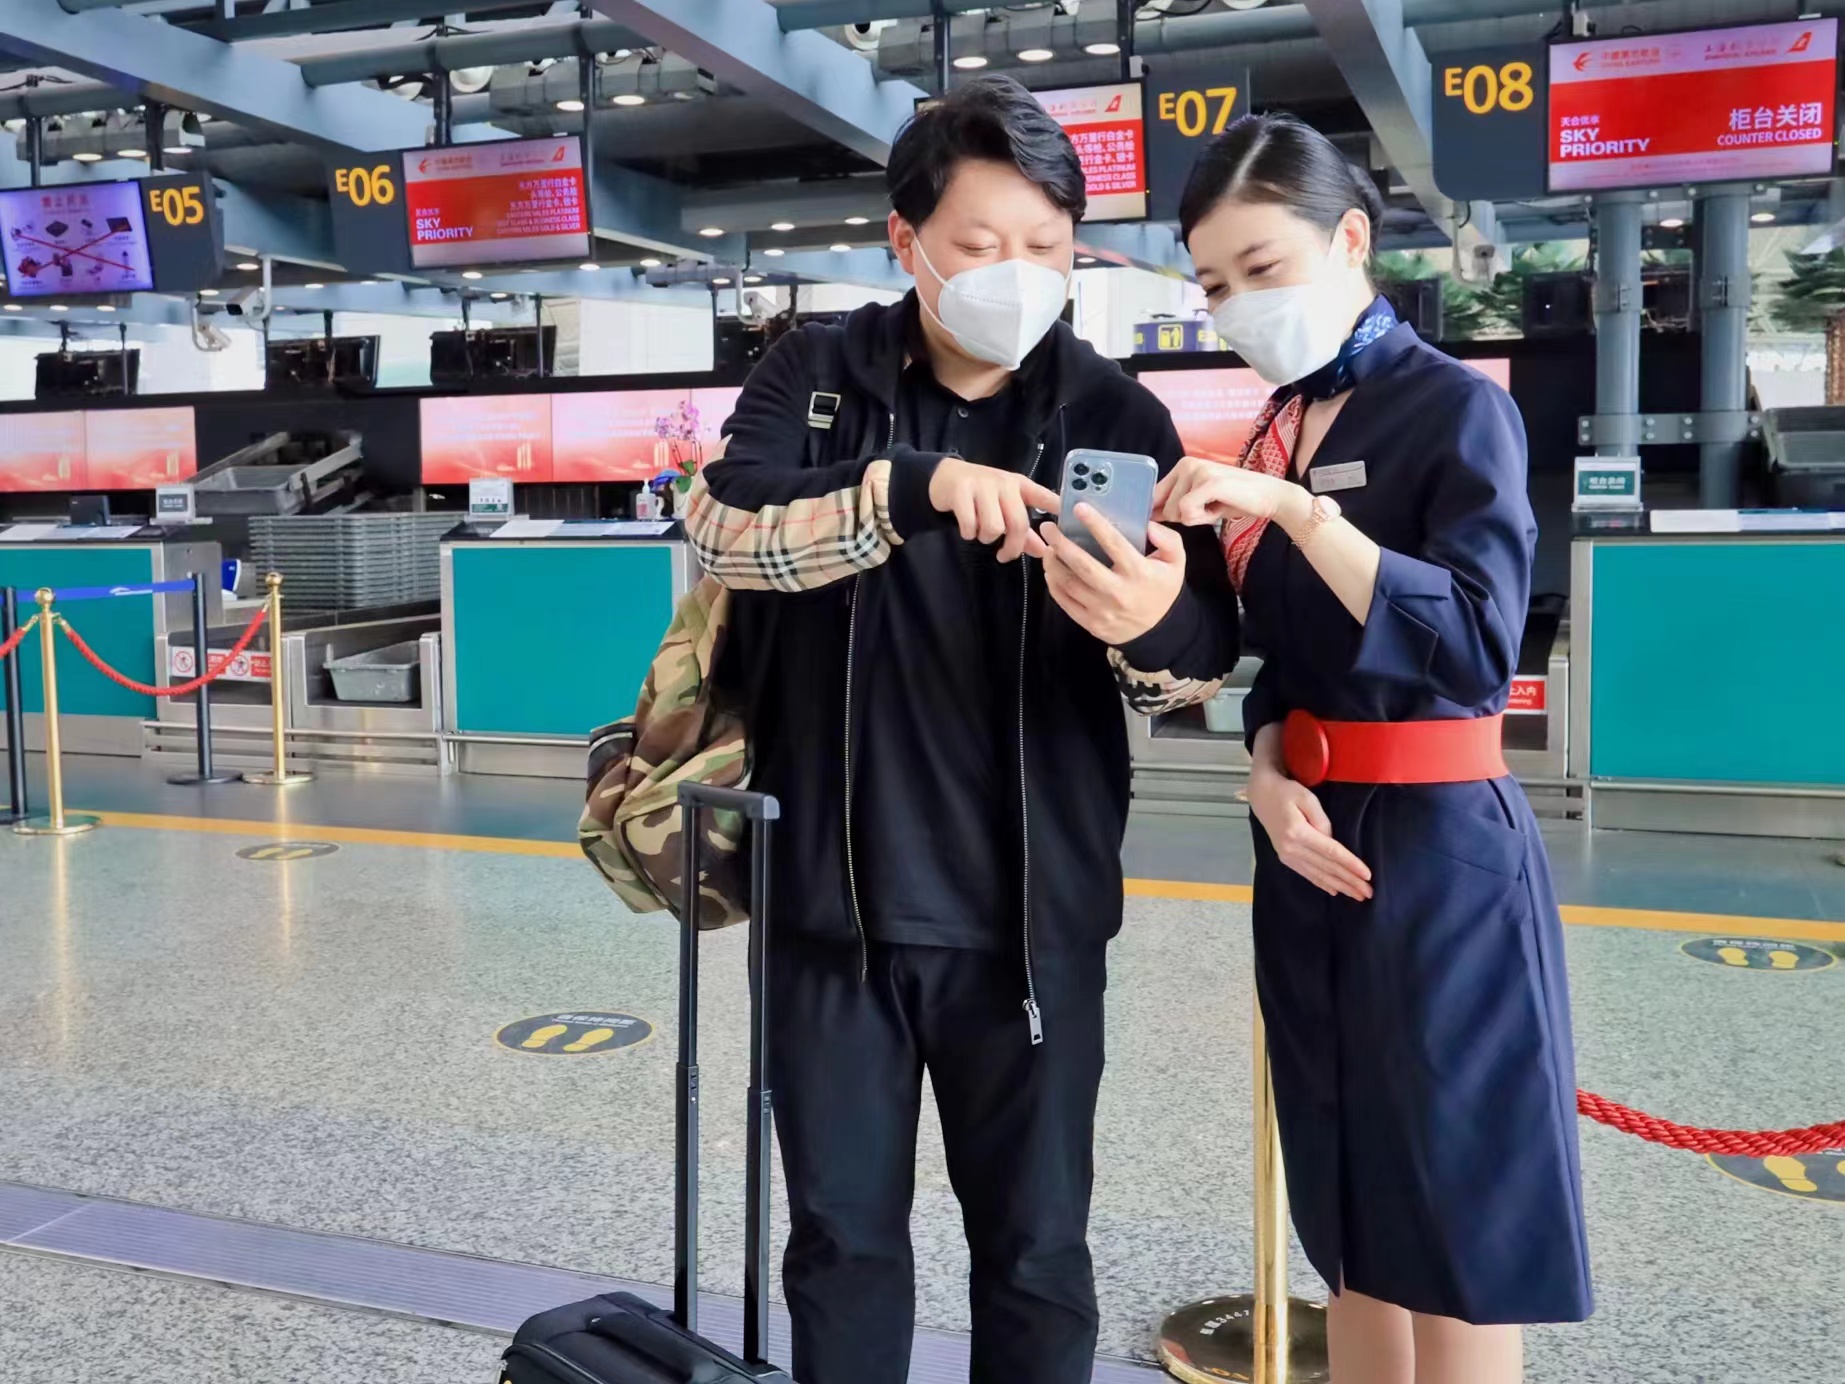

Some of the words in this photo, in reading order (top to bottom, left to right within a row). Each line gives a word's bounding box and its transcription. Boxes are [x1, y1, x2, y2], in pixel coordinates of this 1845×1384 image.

[1444, 62, 1535, 115] E08
[1158, 86, 1237, 137] E07
[1729, 102, 1823, 131] 柜台关闭
[1560, 127, 1600, 143] SKY
[1560, 137, 1651, 158] PRIORITY
[1717, 132, 1773, 146] COUNTER
[1774, 127, 1823, 142] CLOSED
[335, 165, 395, 207] E06
[150, 186, 204, 227] E05
[416, 217, 441, 230] SKY
[417, 227, 473, 241] PRIORITY
